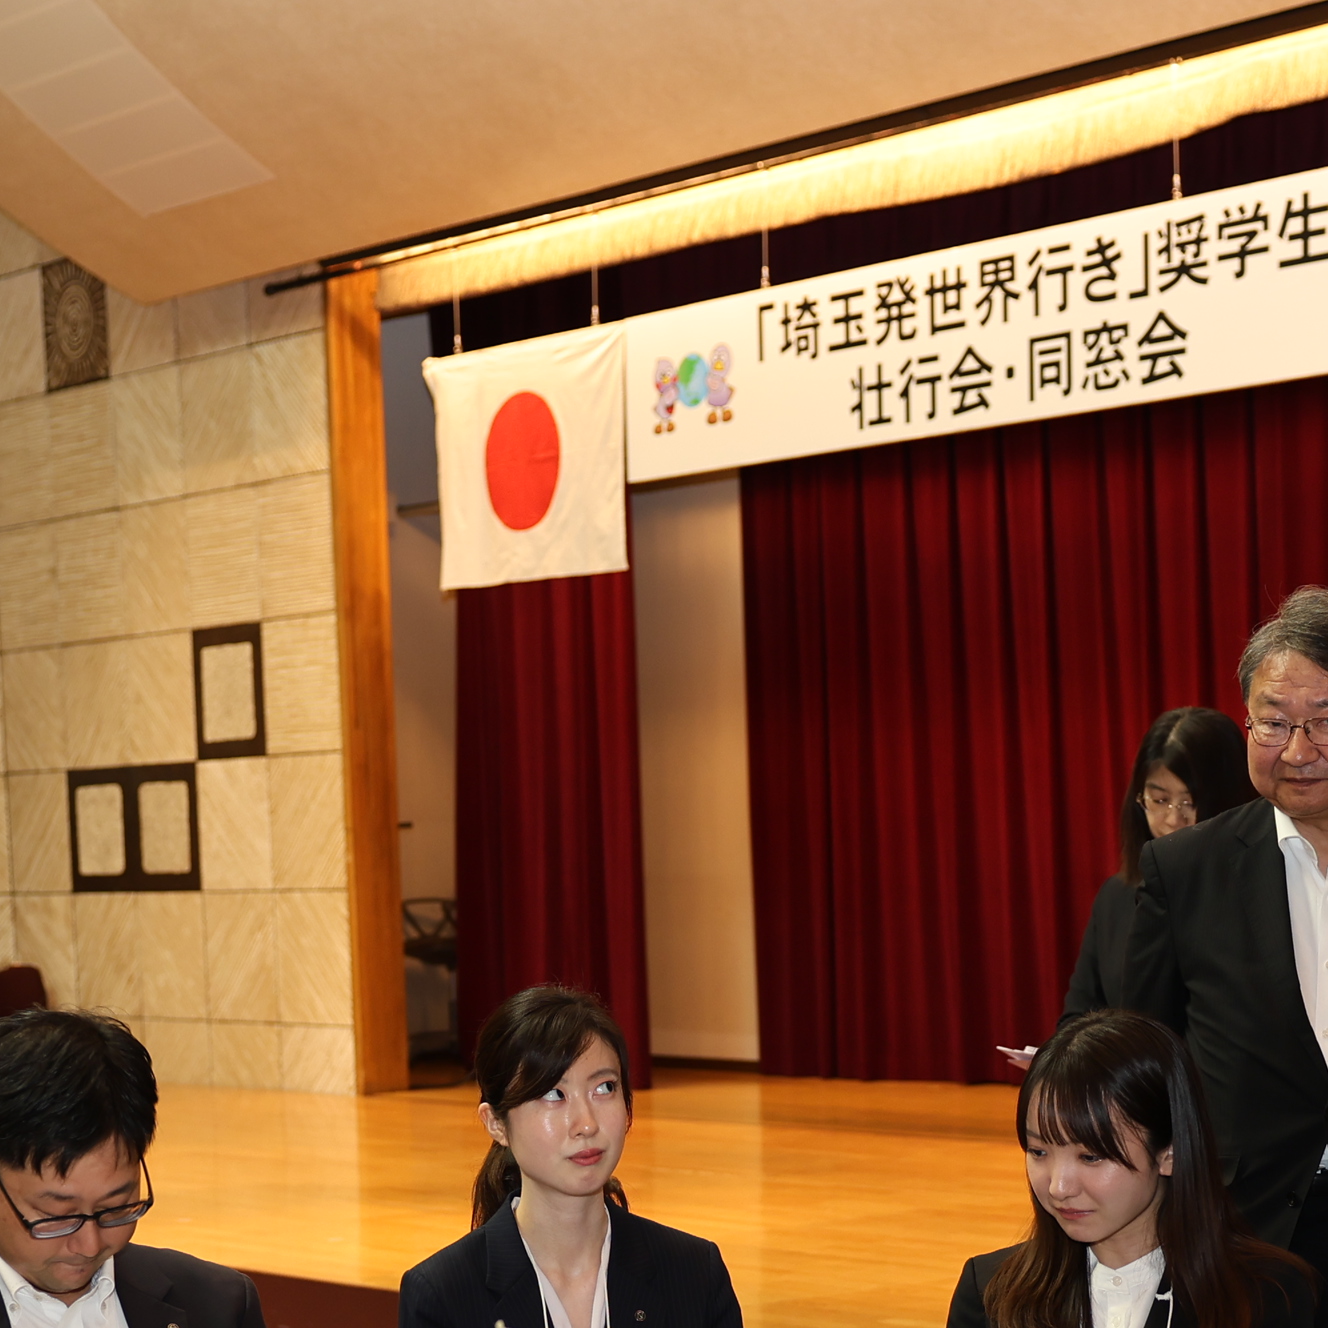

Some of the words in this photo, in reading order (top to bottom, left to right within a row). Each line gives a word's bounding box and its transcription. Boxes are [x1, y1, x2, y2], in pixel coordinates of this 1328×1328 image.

[849, 310, 1189, 431] 壮行会・同窓会
